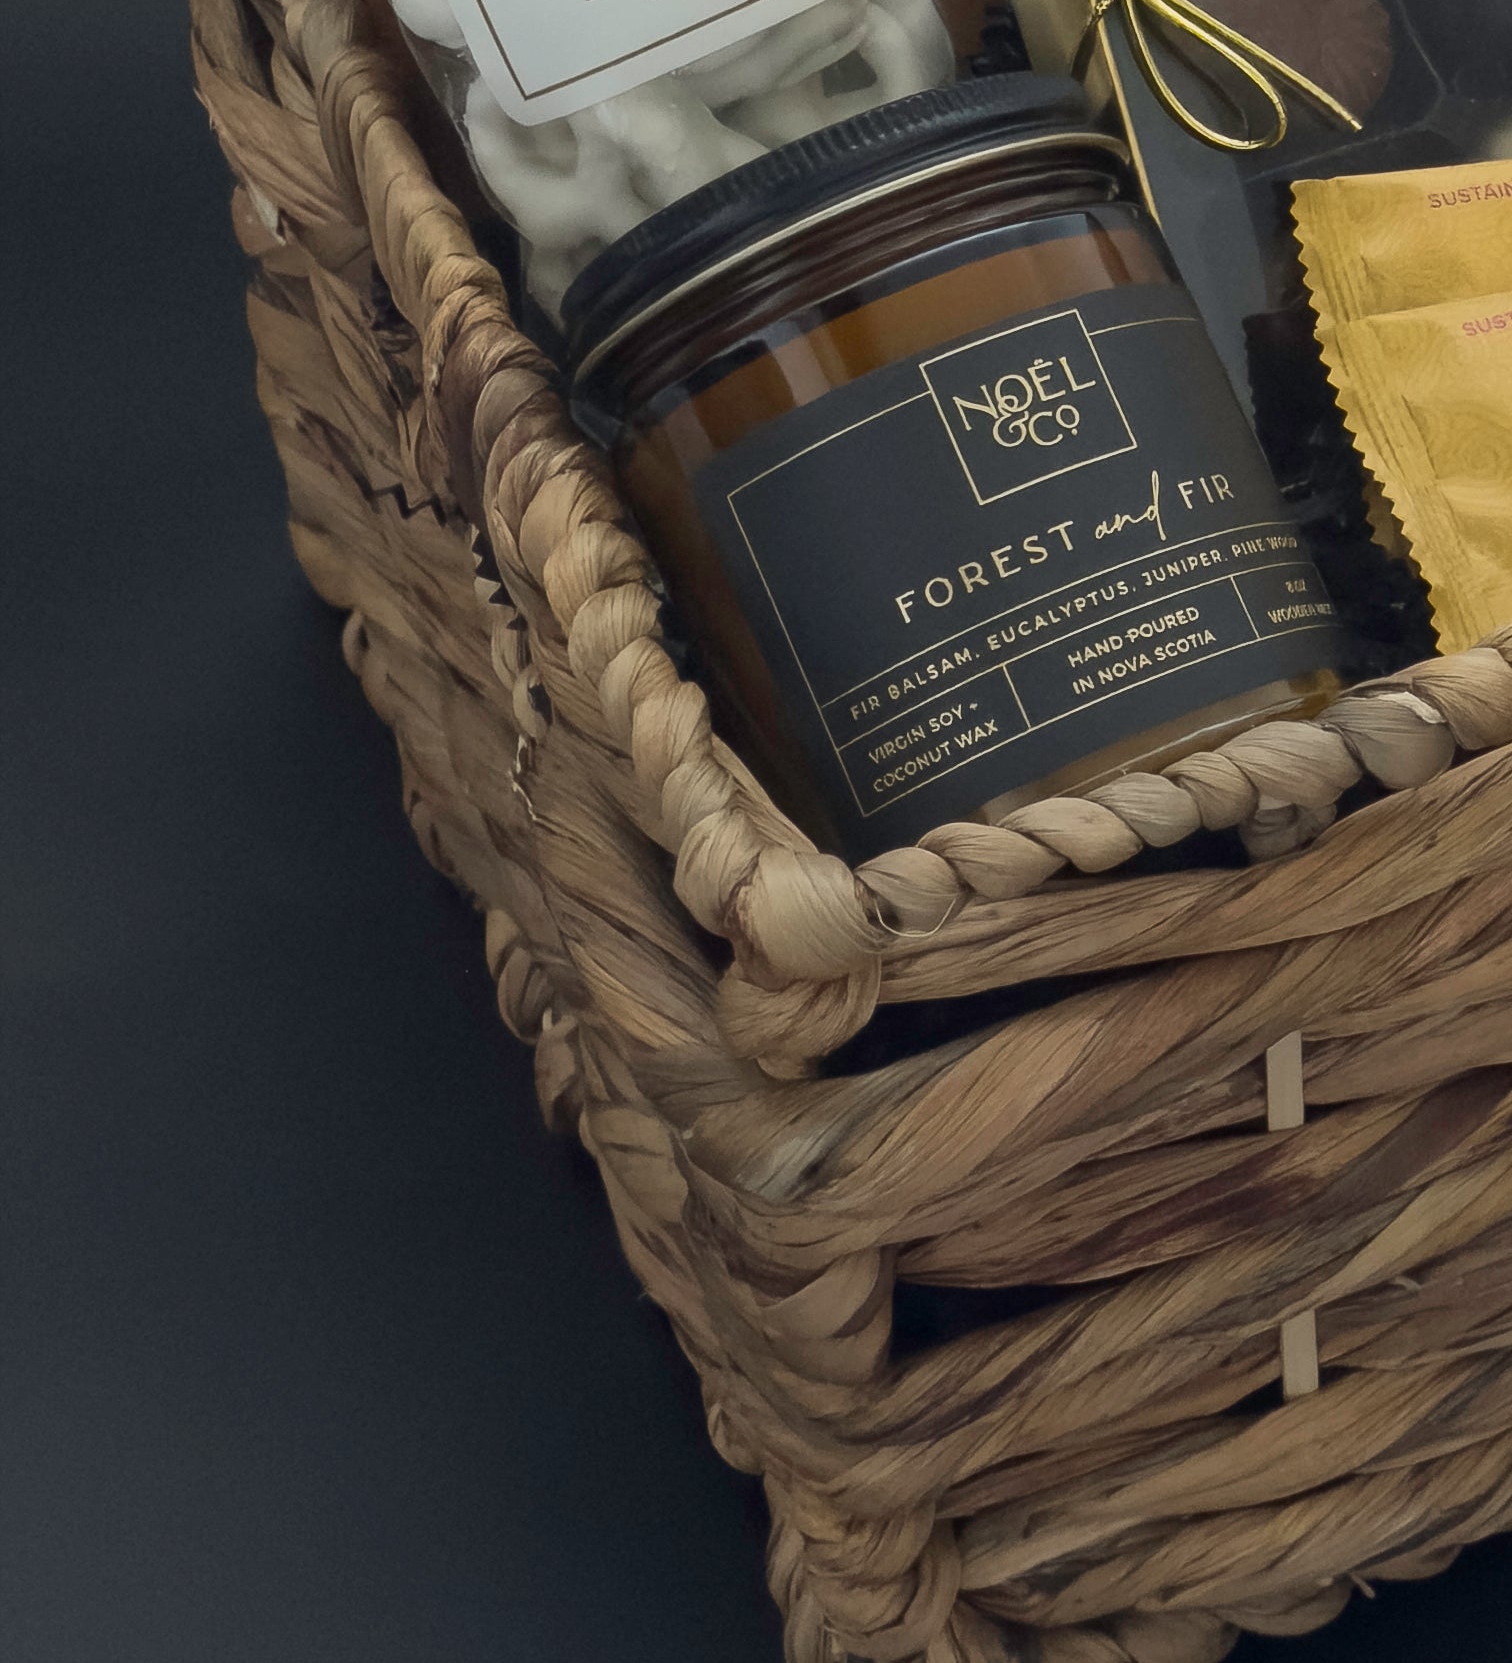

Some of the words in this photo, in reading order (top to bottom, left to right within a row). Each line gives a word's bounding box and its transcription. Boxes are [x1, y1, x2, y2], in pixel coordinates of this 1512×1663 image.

[952, 357, 1097, 431] NOËL
[895, 521, 1075, 624] FOREST
[1094, 469, 1167, 541] and
[1177, 473, 1235, 510] FIR
[1072, 676, 1095, 696] IN
[1097, 653, 1153, 685] NOVA
[1153, 629, 1217, 661] SCOTIA
[850, 695, 881, 721] FIR
[868, 725, 926, 765] VIRGIN
[928, 703, 963, 733] SOY
[872, 741, 951, 793] COCONUT
[954, 719, 999, 749] WAX
